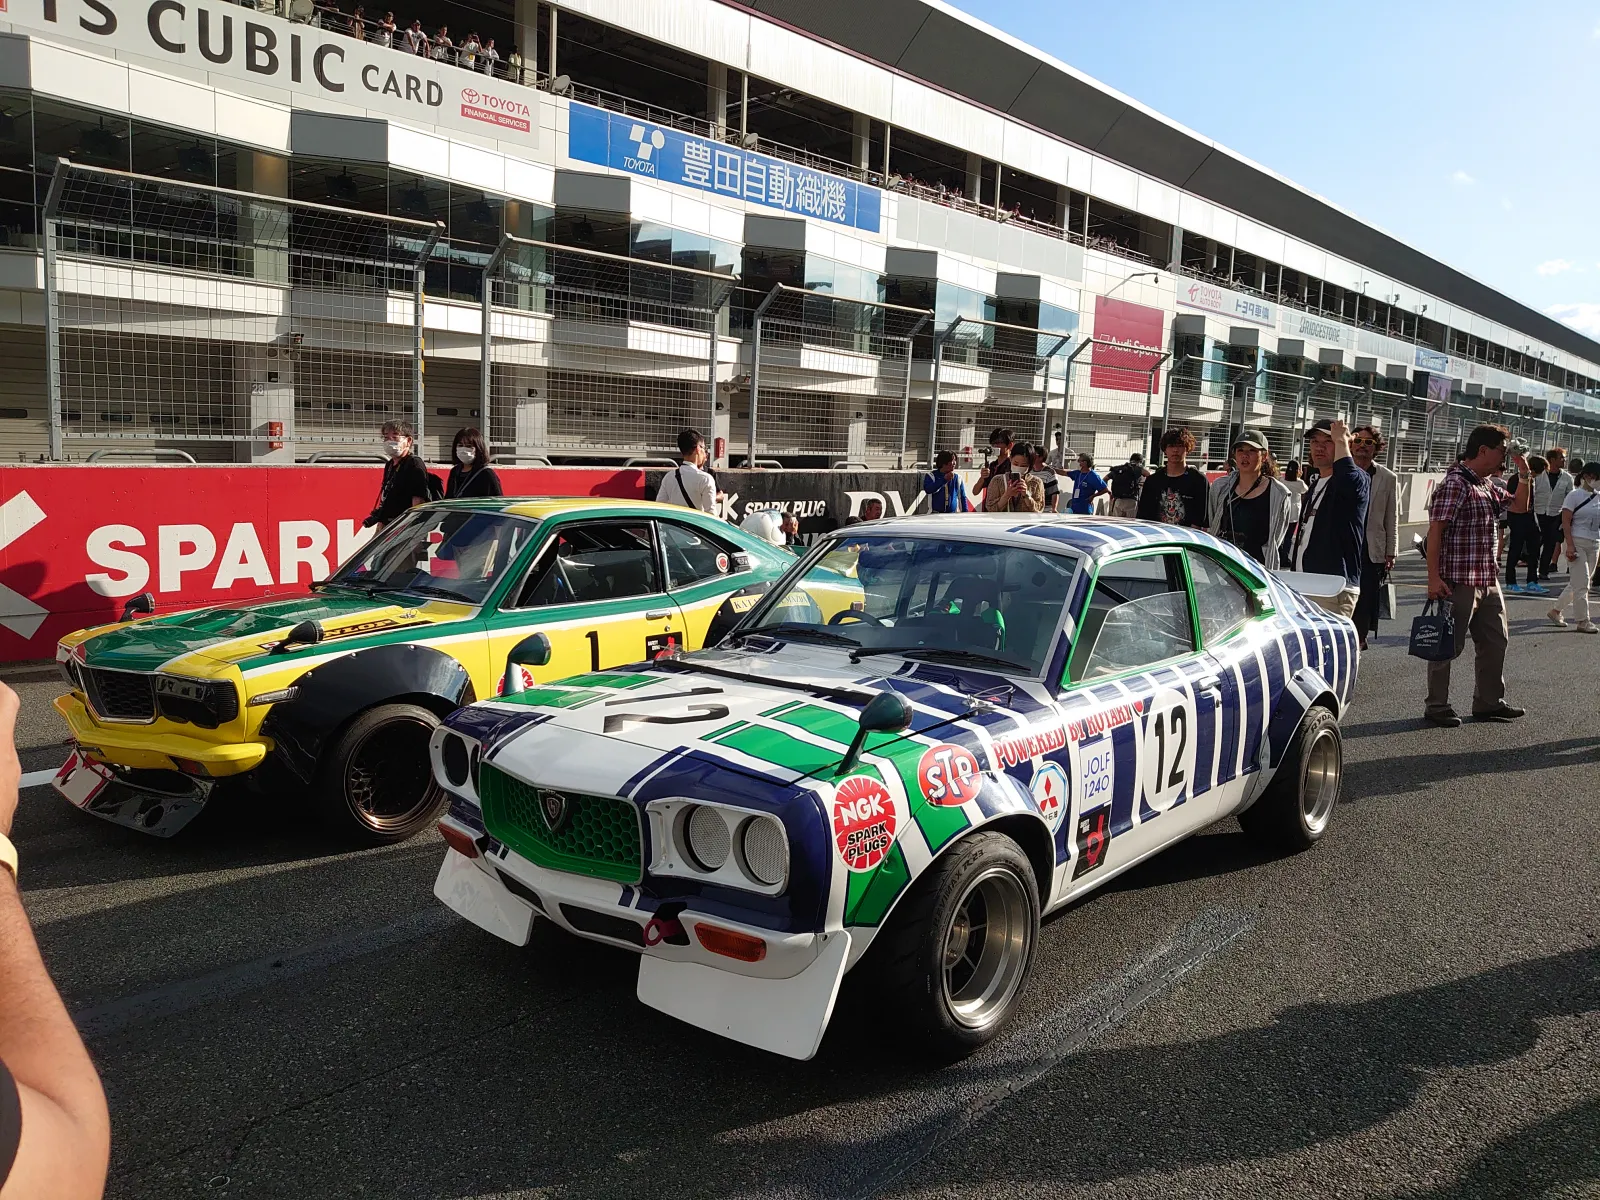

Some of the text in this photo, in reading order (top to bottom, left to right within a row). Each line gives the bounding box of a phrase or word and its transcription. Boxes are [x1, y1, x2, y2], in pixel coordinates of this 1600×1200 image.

[147, 0, 345, 93] CUBIC
[361, 64, 444, 107] CARD
[482, 94, 530, 117] TOYOTA
[464, 107, 528, 130] FINANCIAL SERVICES
[623, 156, 655, 175] TOYOTA
[682, 141, 846, 222] 豊田自動織機
[1200, 286, 1222, 300] TOYOTA
[1299, 316, 1340, 342] BRIDGESTONE
[1109, 336, 1159, 357] Audi Sport
[251, 384, 264, 395] 28
[743, 501, 790, 519] SPARK
[792, 500, 826, 518] PLUG
[585, 630, 600, 672] 1
[991, 704, 1132, 769] POWERED BY ROTARY
[1154, 704, 1187, 794] 12
[926, 749, 973, 798] STP
[1084, 751, 1110, 779] JOLF
[1084, 775, 1110, 799] 1240
[839, 793, 886, 826] NGK
[847, 821, 887, 846] SPARK
[847, 836, 888, 860] PLUGS
